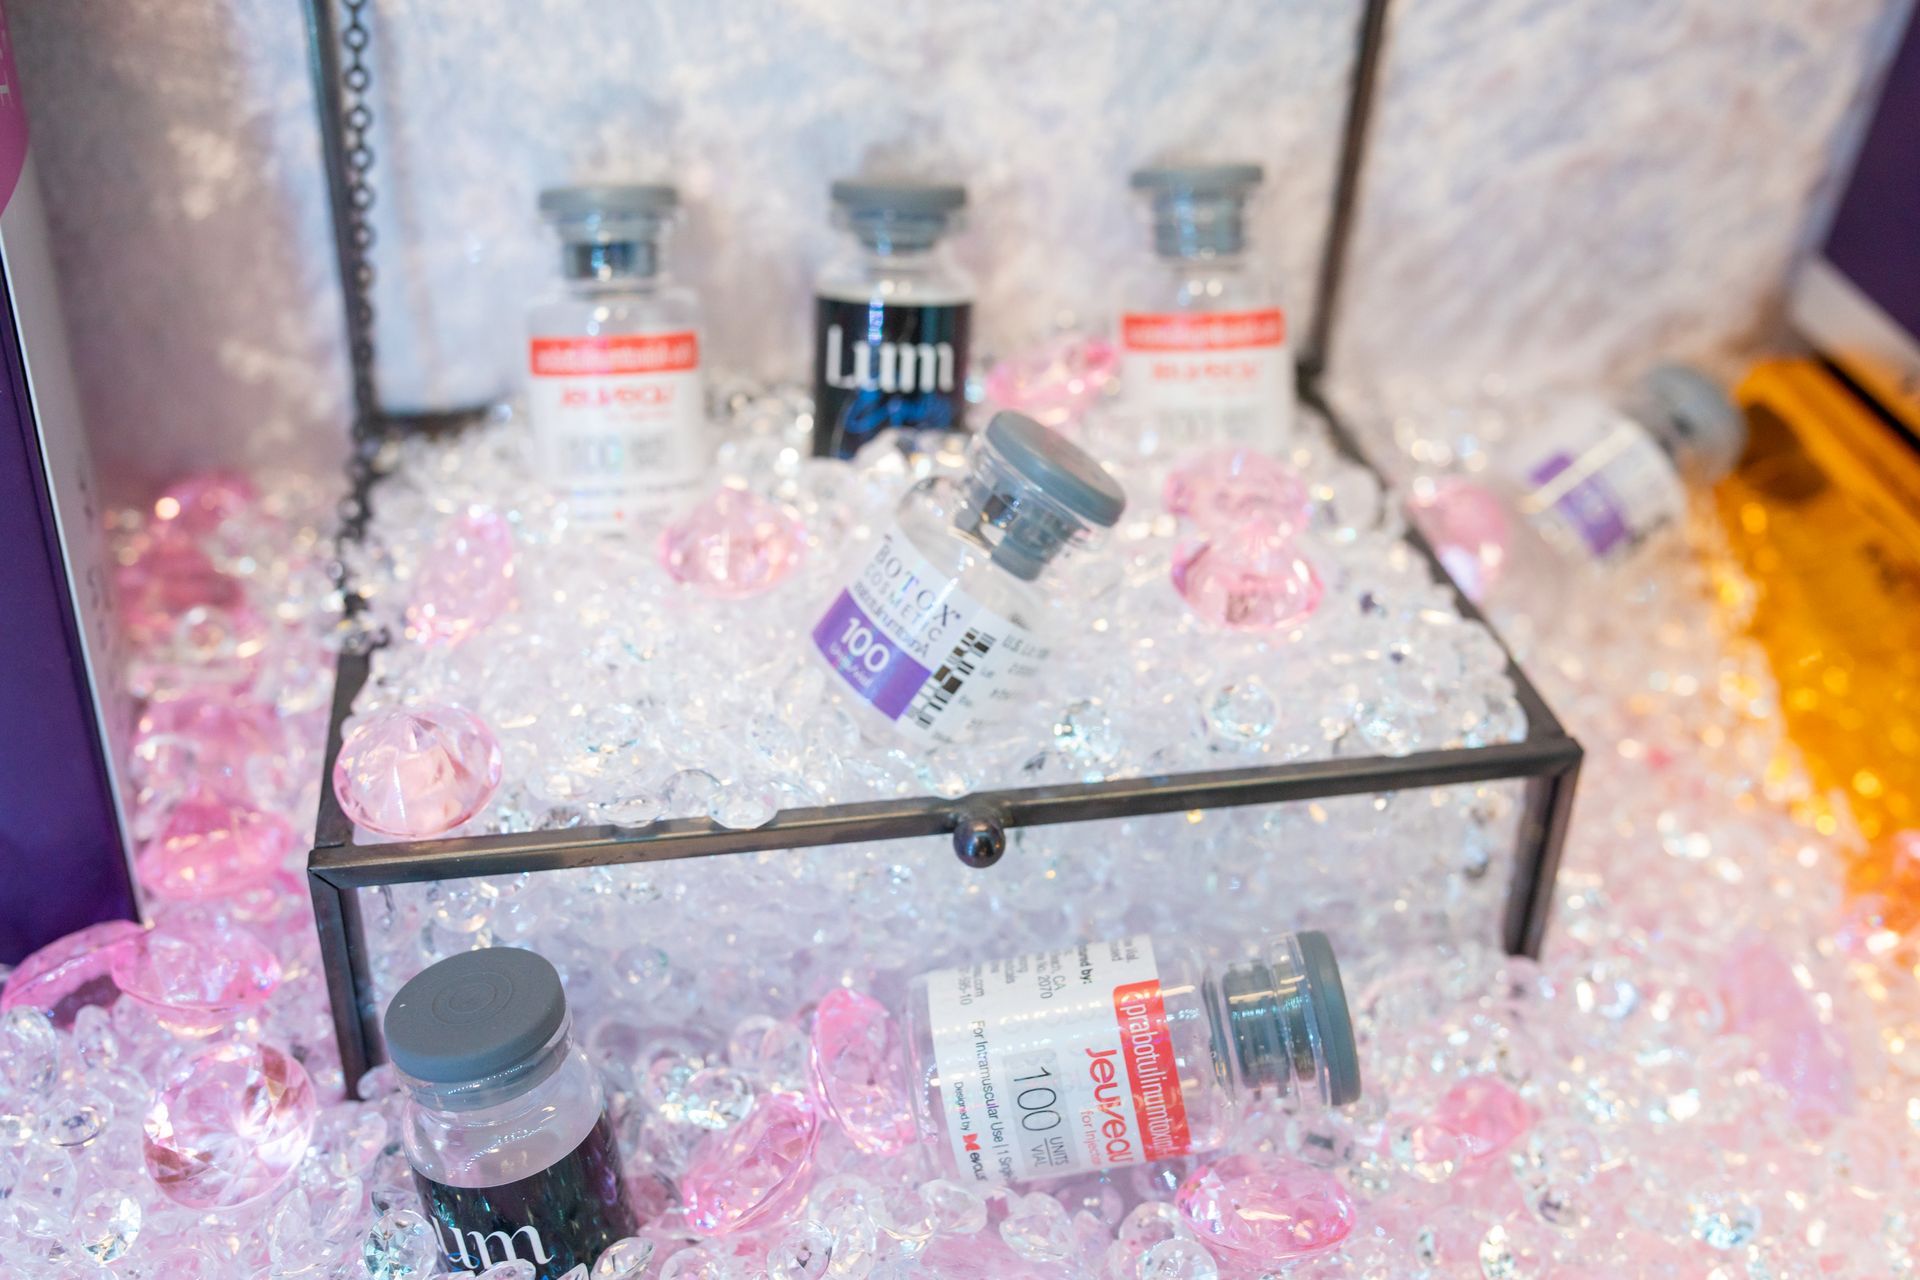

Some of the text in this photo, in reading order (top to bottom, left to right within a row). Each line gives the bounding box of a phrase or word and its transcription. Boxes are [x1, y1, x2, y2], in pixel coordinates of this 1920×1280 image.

[840, 617, 890, 673] 100
[1037, 975, 1053, 999] 2070
[1053, 975, 1066, 991] CA
[1080, 968, 1094, 985] by:
[971, 1020, 986, 1040] For
[975, 1040, 1000, 1120] Intramuscular
[954, 1081, 971, 1121] Designed
[1013, 1066, 1062, 1131] 100
[1085, 1048, 1134, 1163] Jeuveau
[961, 1121, 972, 1131] by
[1080, 1110, 1095, 1127] for
[990, 1121, 1005, 1144] Use
[1031, 1144, 1048, 1168] VIAL
[1050, 1136, 1070, 1167] UNITS
